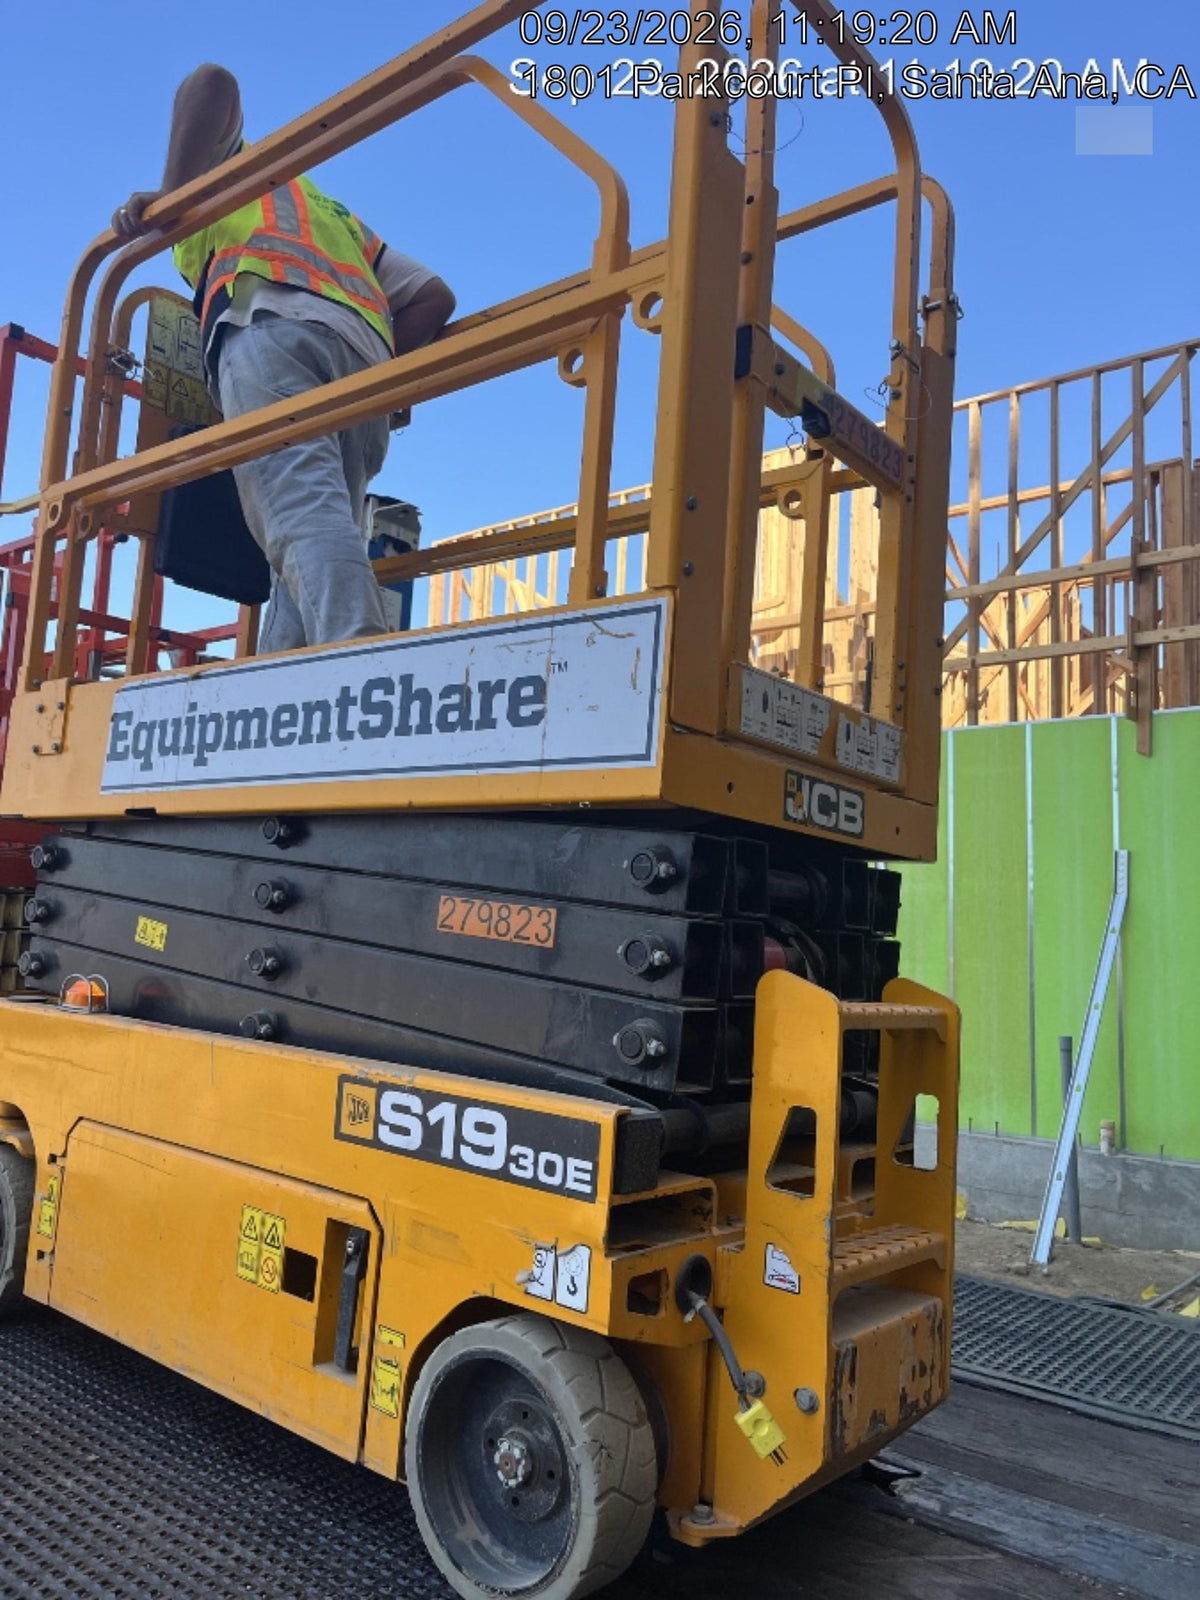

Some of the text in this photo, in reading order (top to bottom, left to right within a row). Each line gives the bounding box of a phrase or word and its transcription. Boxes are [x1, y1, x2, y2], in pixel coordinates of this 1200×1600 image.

[106, 673, 547, 771] EquipmentShare
[785, 775, 864, 834] JCB
[438, 897, 553, 944] 279823
